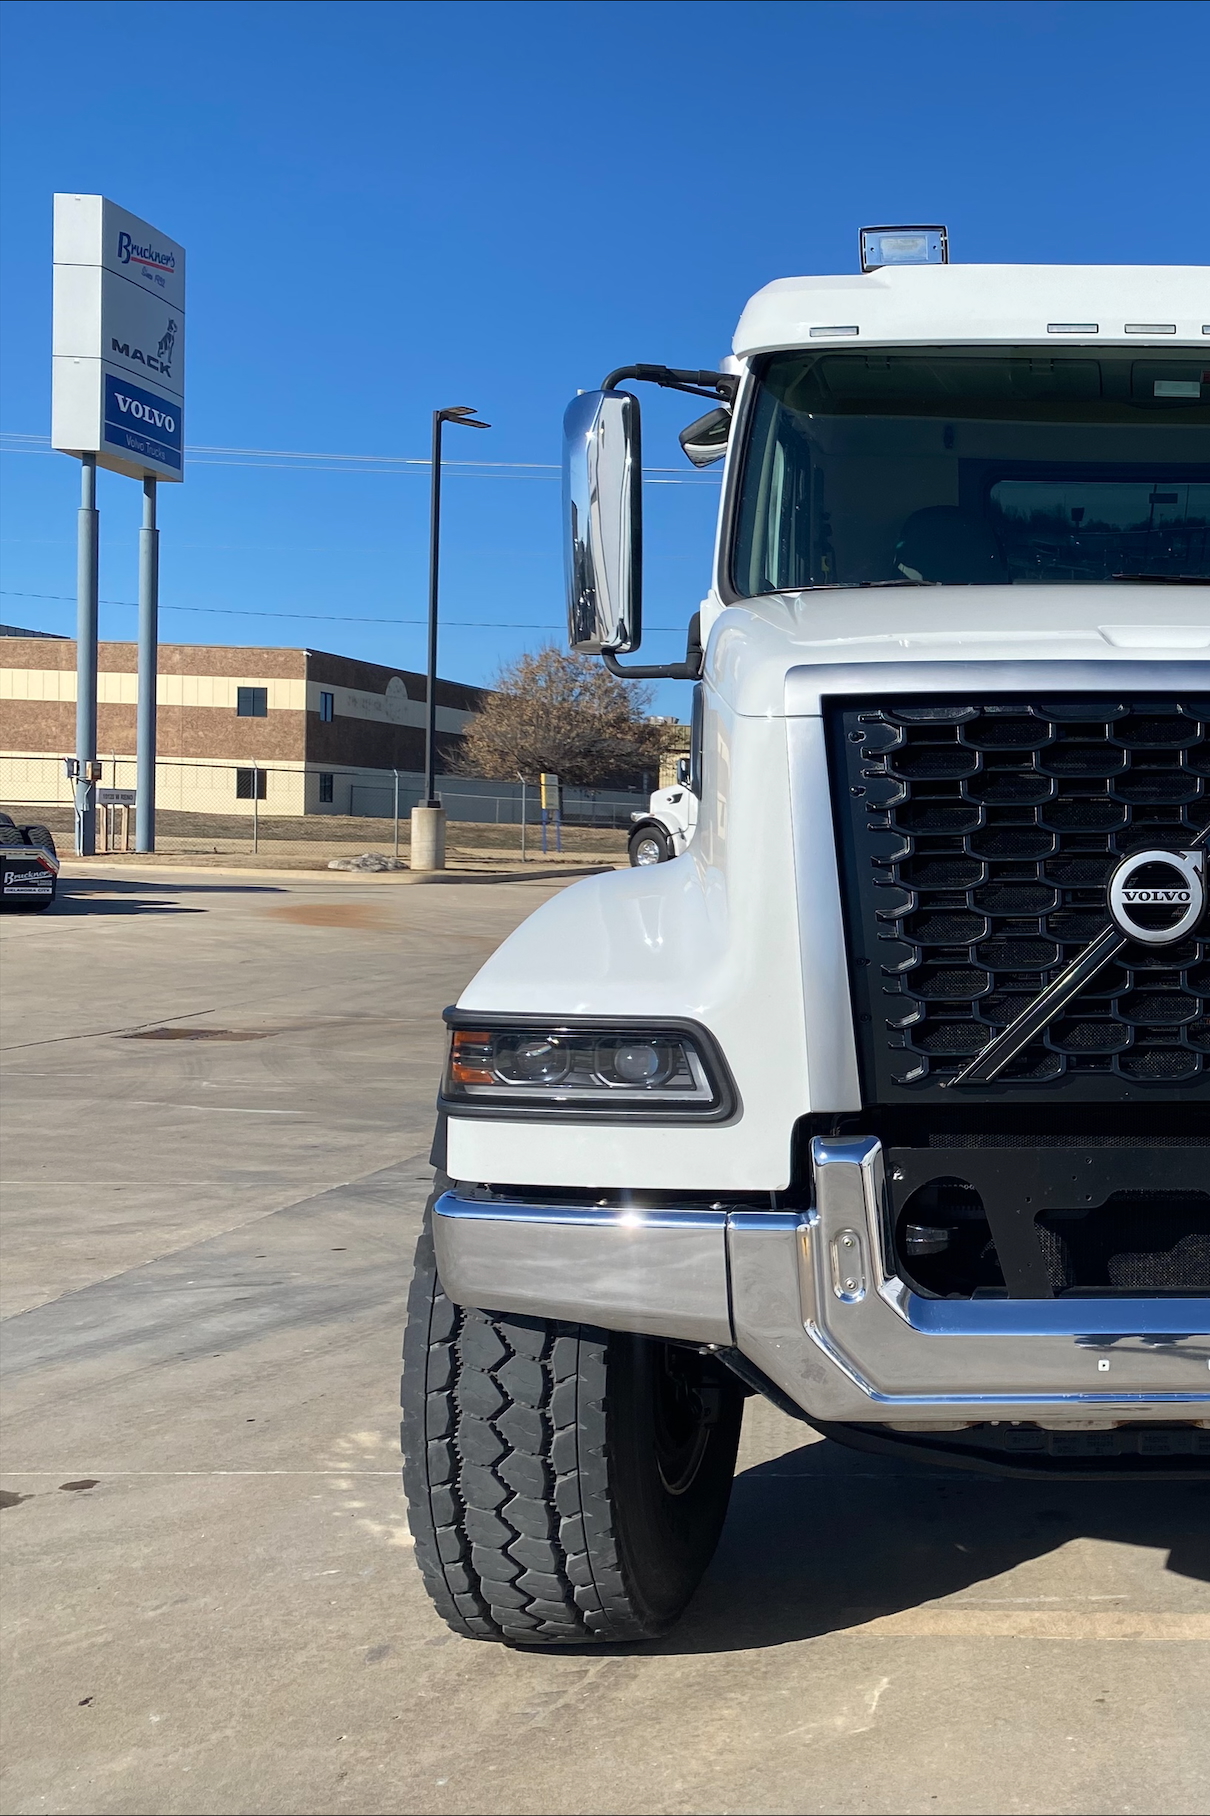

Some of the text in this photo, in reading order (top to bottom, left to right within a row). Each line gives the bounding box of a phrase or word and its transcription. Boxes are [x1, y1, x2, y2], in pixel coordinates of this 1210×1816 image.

[117, 231, 176, 268] Bruckner's
[111, 337, 172, 379] MACK
[114, 392, 175, 433] VOLVO
[126, 434, 166, 460] Volvo Trucks
[1121, 891, 1191, 902] VOLVO
